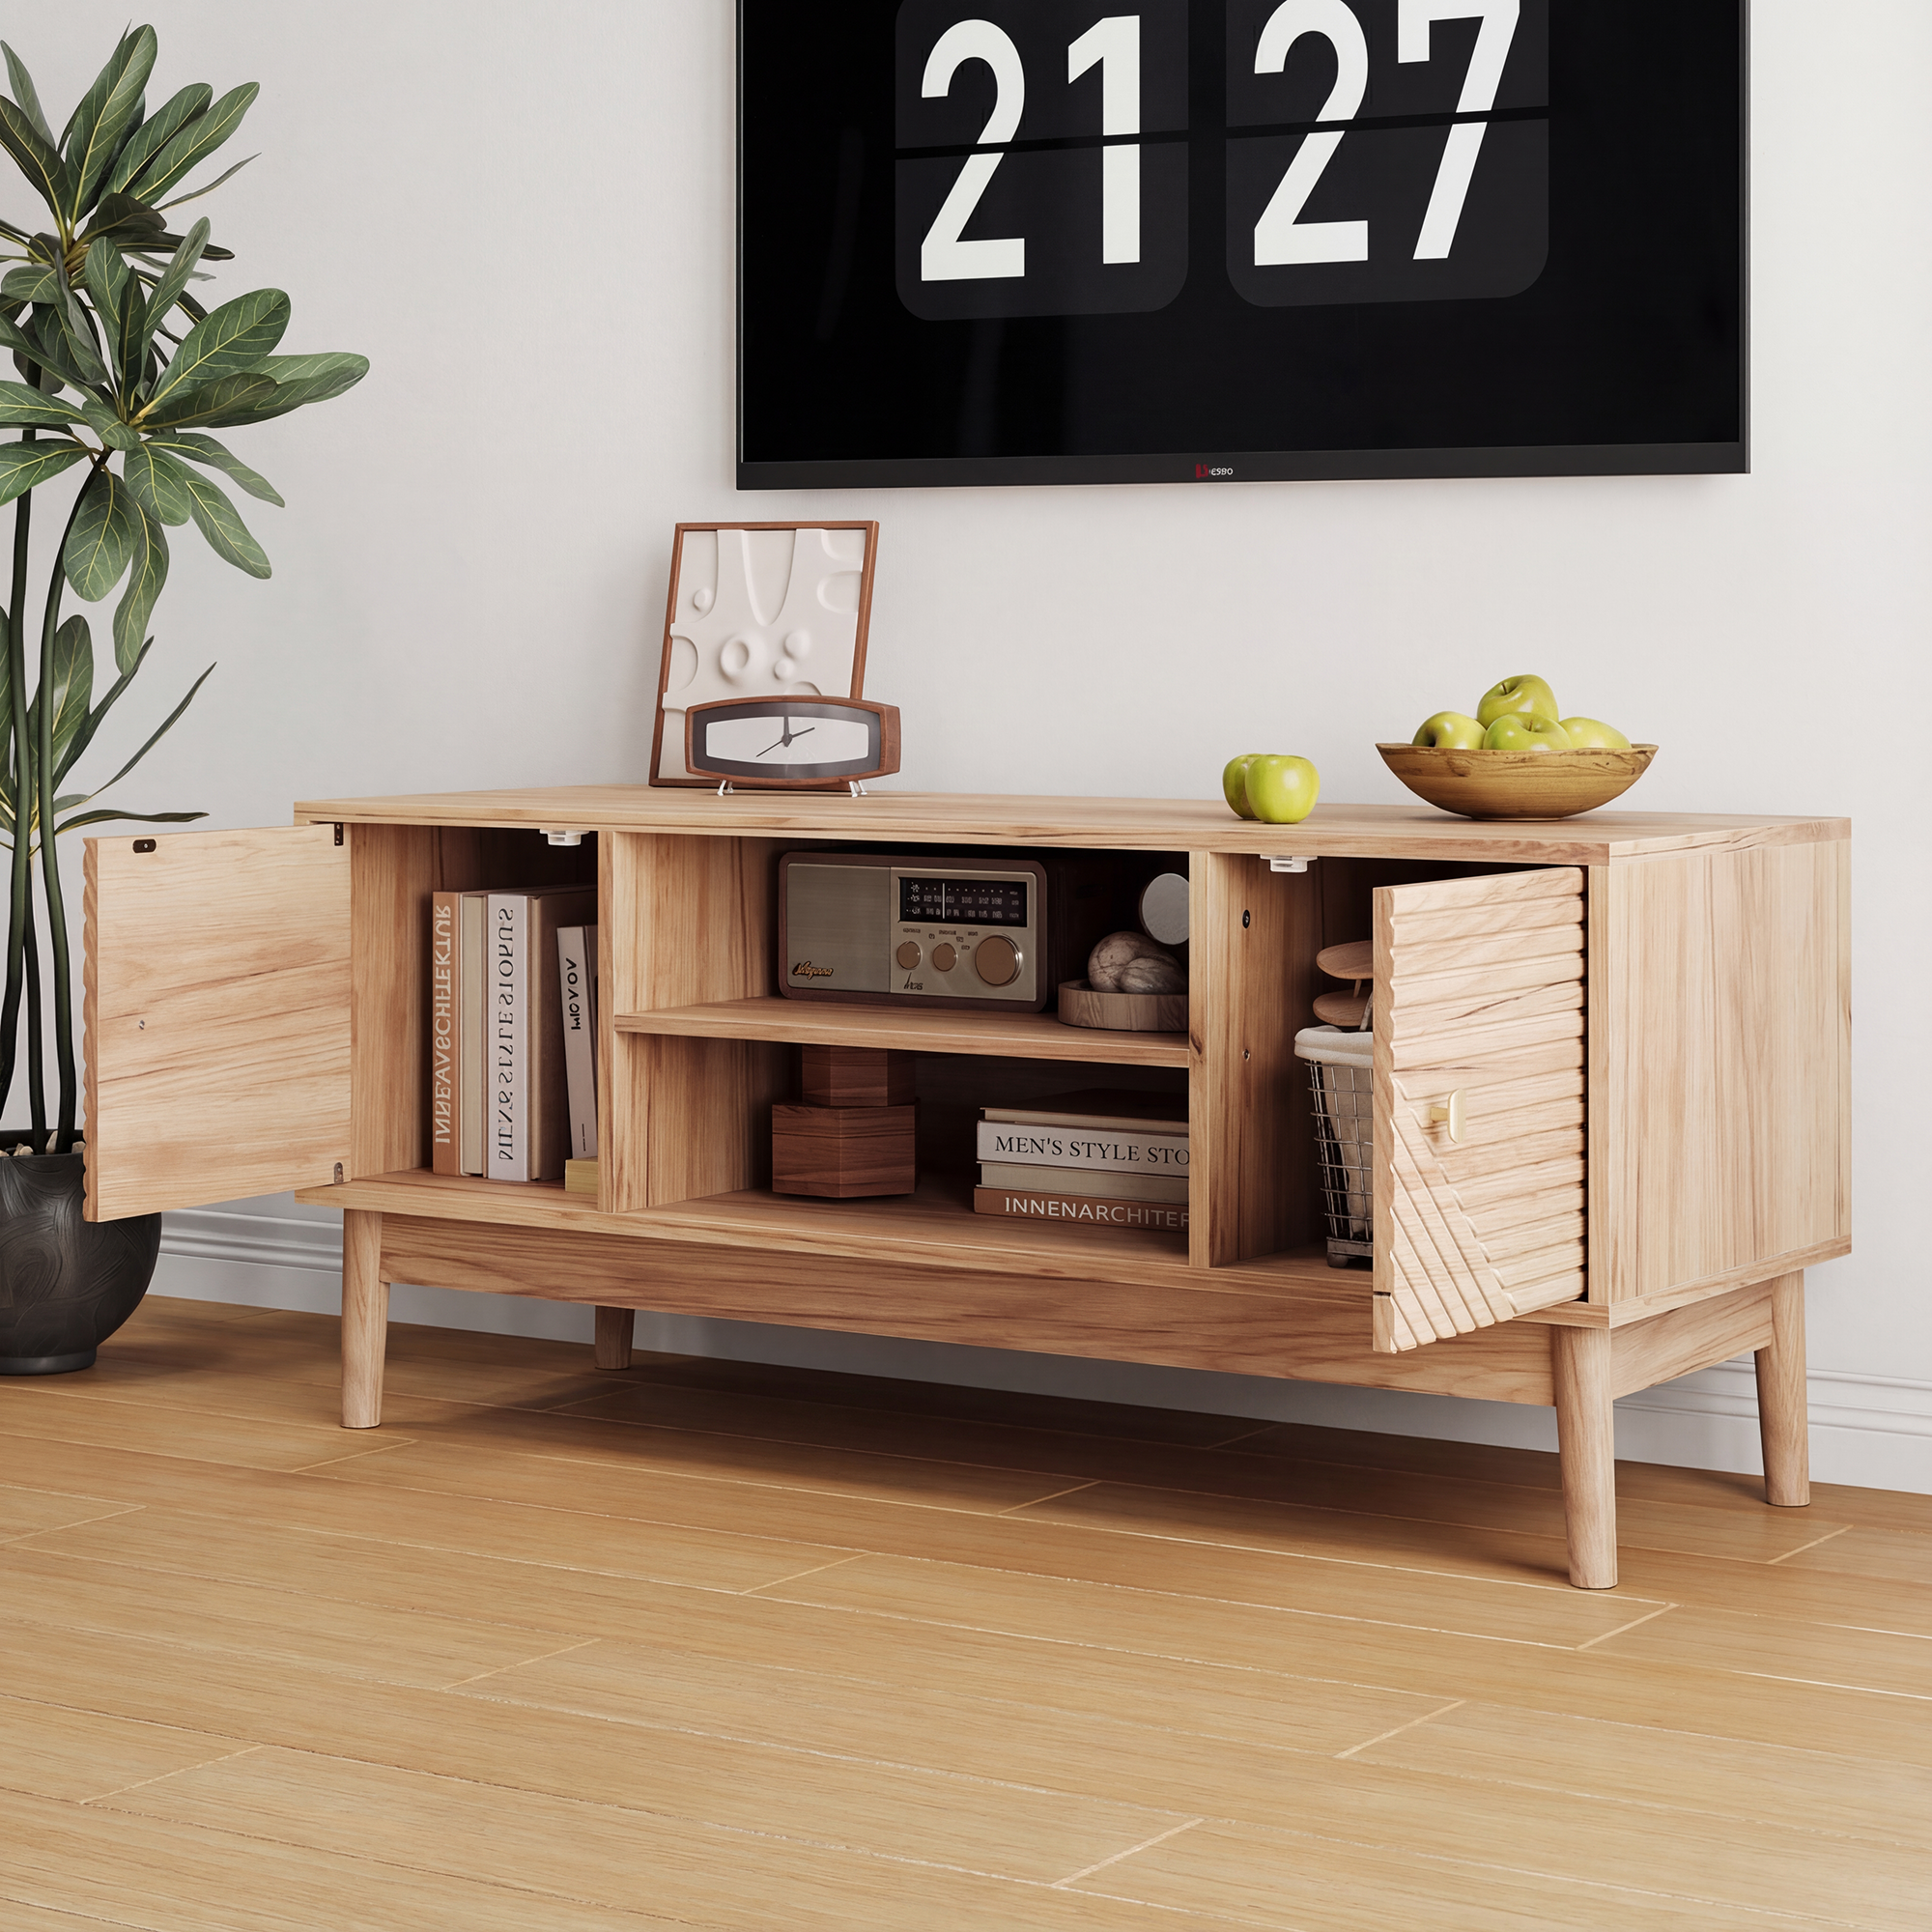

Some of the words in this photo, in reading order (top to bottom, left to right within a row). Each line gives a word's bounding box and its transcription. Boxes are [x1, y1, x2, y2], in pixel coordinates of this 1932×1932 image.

[922, 15, 1140, 281] 21
[1254, 0, 1520, 266] 27
[995, 1135, 1063, 1156] MEN'S
[1069, 1140, 1141, 1162] STYLE
[1147, 1147, 1189, 1166] STO
